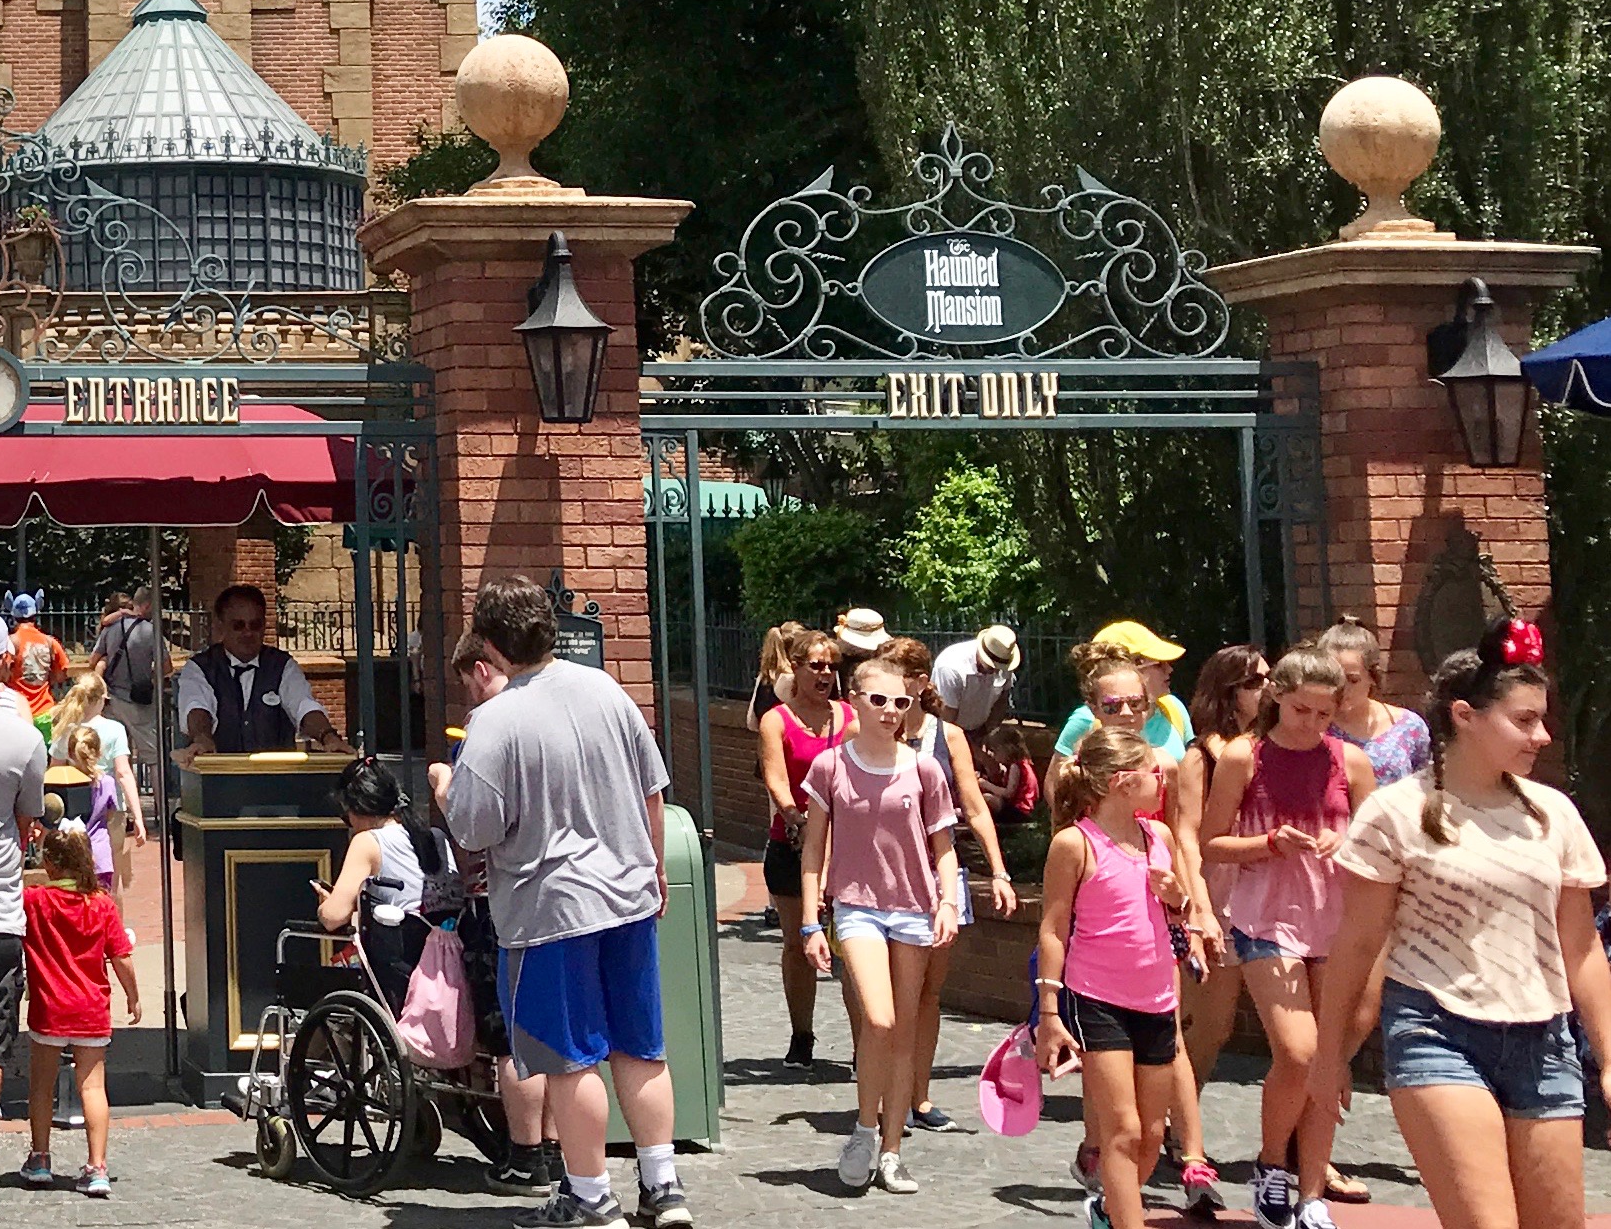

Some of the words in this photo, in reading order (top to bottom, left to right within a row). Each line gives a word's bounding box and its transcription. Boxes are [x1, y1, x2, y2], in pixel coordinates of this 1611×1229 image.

[923, 247, 1000, 287] Haunted
[946, 238, 971, 256] The
[924, 288, 1004, 334] Mansion
[66, 377, 239, 425] ENTRANCE
[888, 372, 965, 419] EXIT
[978, 372, 1059, 419] ONLY
